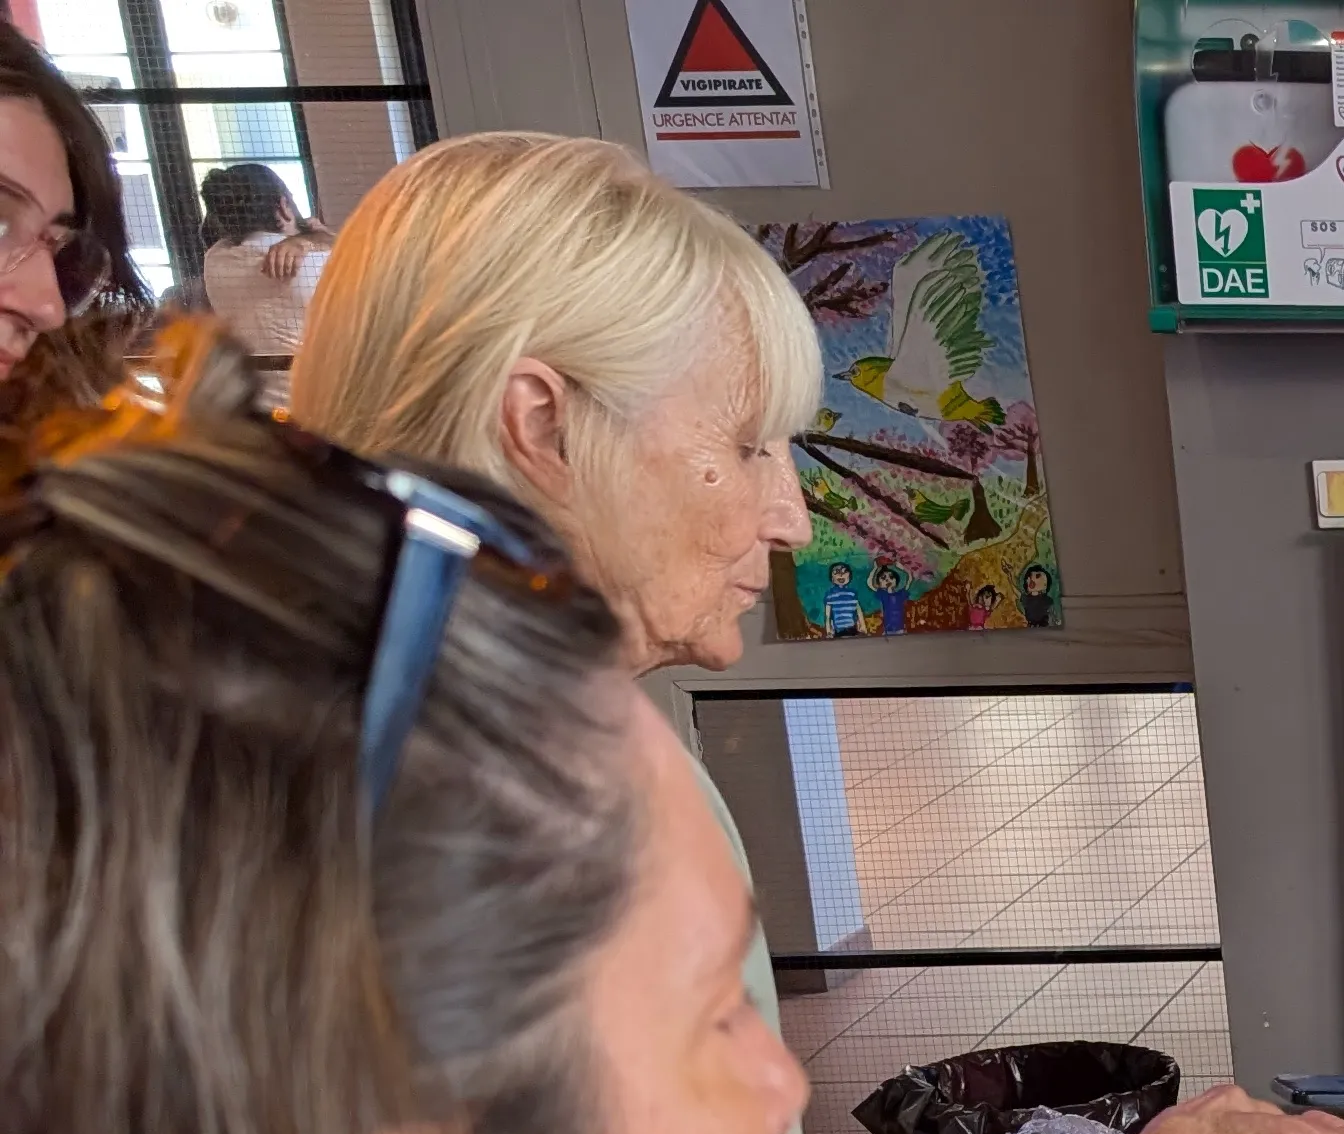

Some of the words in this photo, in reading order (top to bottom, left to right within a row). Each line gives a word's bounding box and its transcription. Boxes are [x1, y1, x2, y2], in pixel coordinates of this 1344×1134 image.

[680, 78, 763, 91] VIGIPIRATE
[652, 112, 724, 128] URGENCE
[729, 111, 797, 127] ATTENTAT
[1310, 221, 1338, 232] SOS
[1203, 268, 1266, 294] DAE
